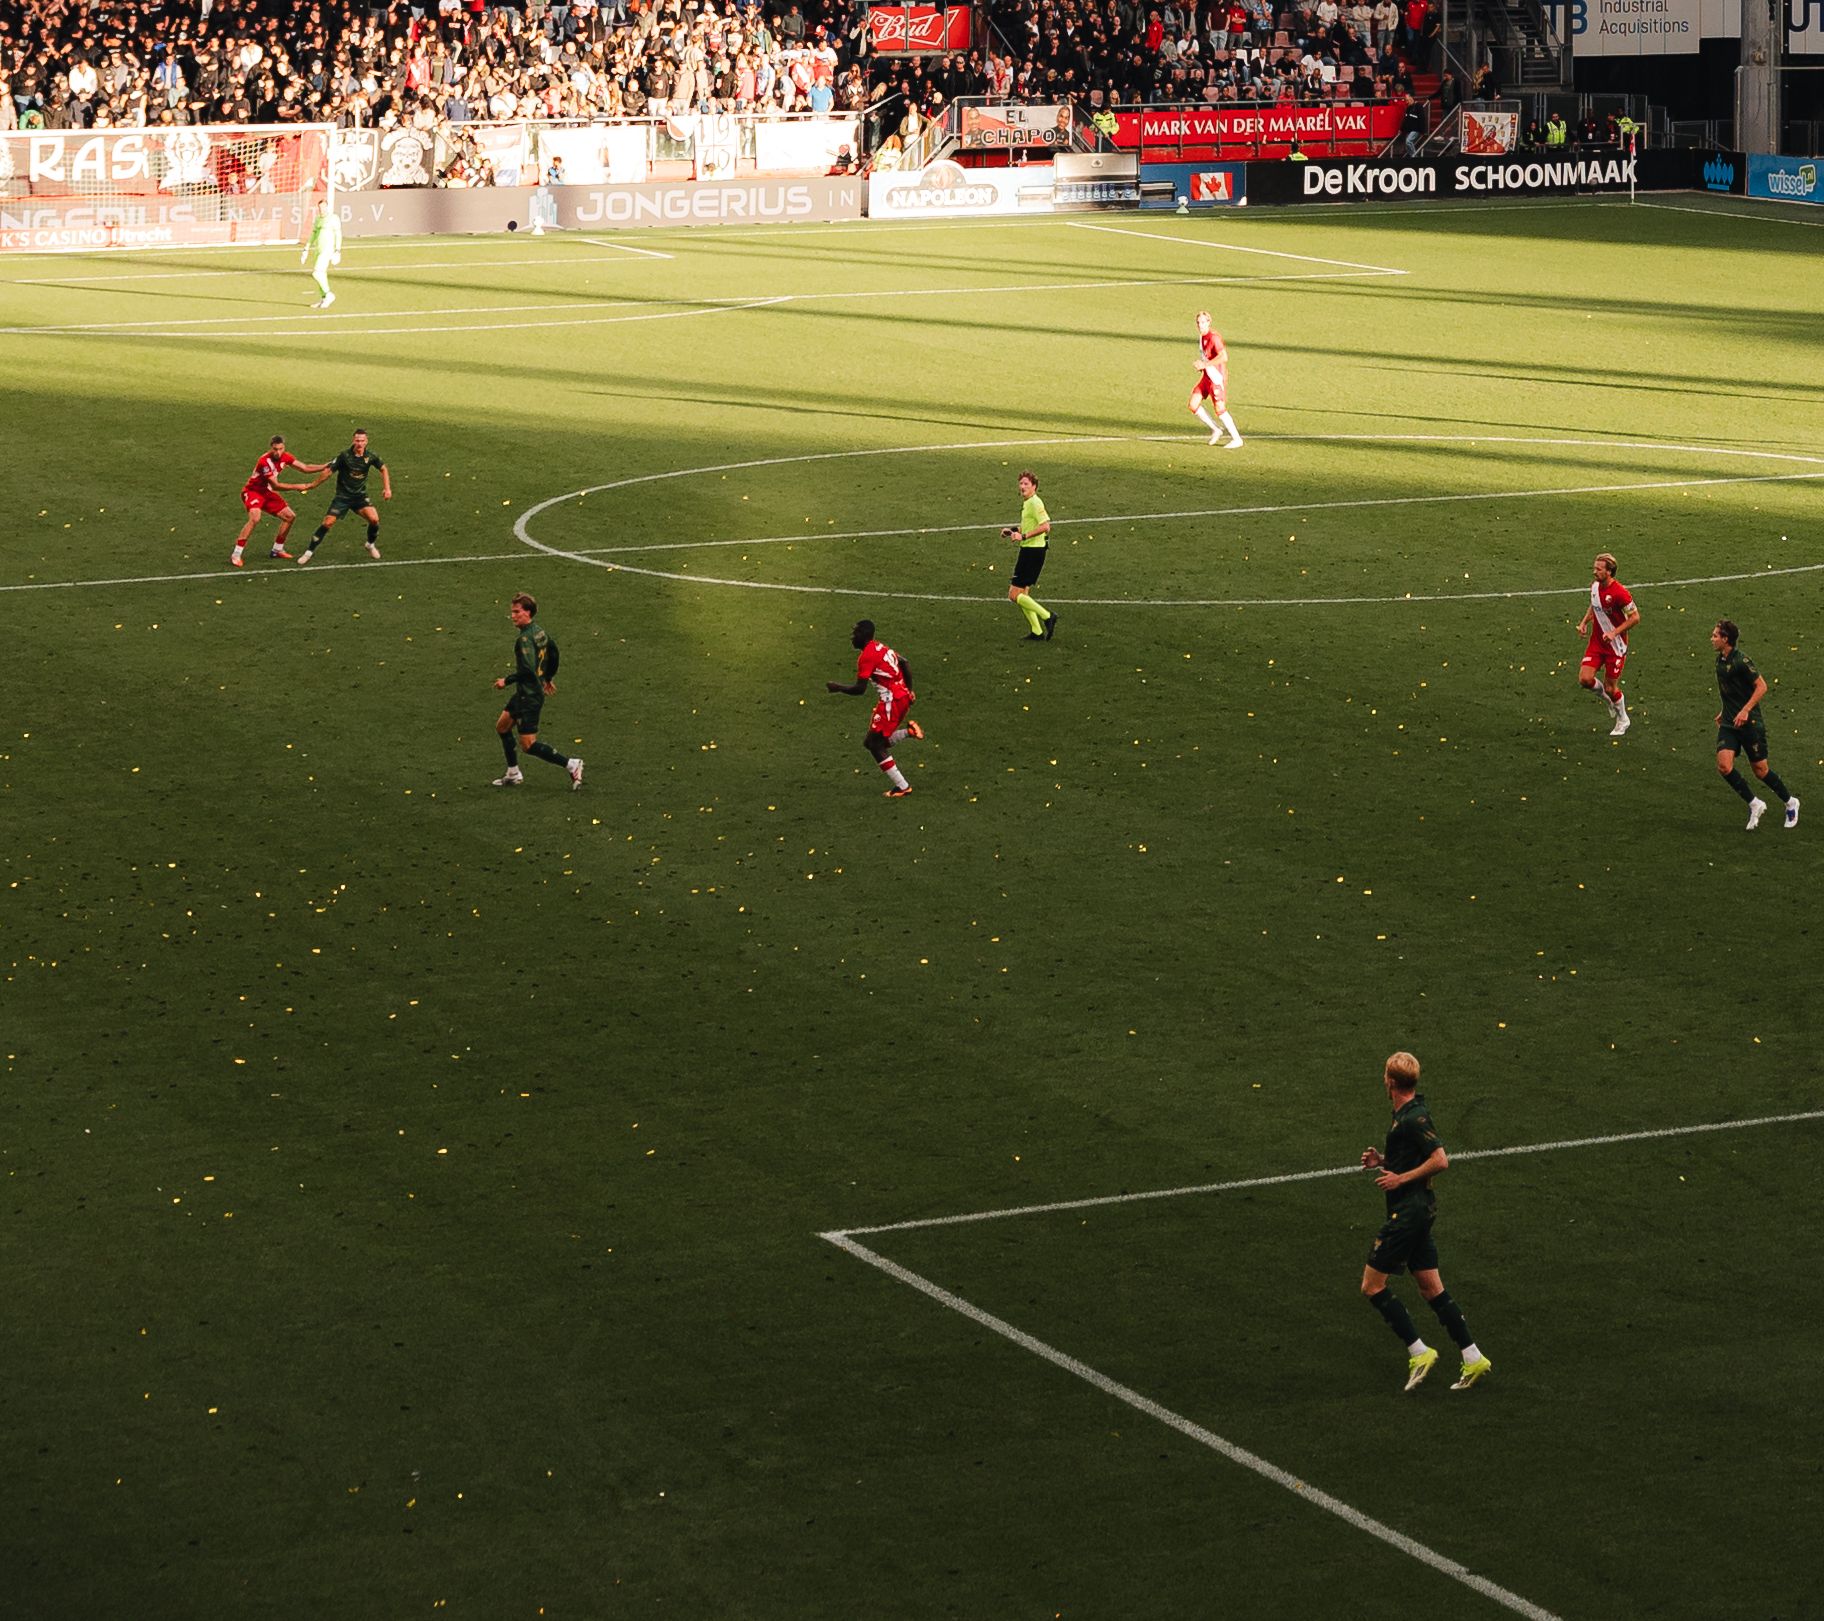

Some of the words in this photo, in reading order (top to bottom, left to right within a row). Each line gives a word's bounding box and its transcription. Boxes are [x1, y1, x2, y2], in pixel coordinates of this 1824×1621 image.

[874, 15, 932, 38] Bud
[1599, 19, 1689, 37] Acquisitions
[1005, 109, 1029, 125] EL
[1143, 114, 1191, 136] MARK
[1193, 116, 1229, 134] VAN
[1232, 116, 1264, 134] DER
[1268, 114, 1333, 133] MAAREL
[1335, 113, 1367, 131] VAK
[981, 127, 1057, 147] CHAPO
[1454, 159, 1637, 191] SCHOONMAAK
[576, 186, 812, 222] JONGERIUS
[829, 189, 854, 207] IN
[891, 187, 993, 208] NAPOLEON
[341, 204, 393, 222] B.V.
[34, 229, 106, 245] CASINO
[112, 227, 173, 244] Utrecht
